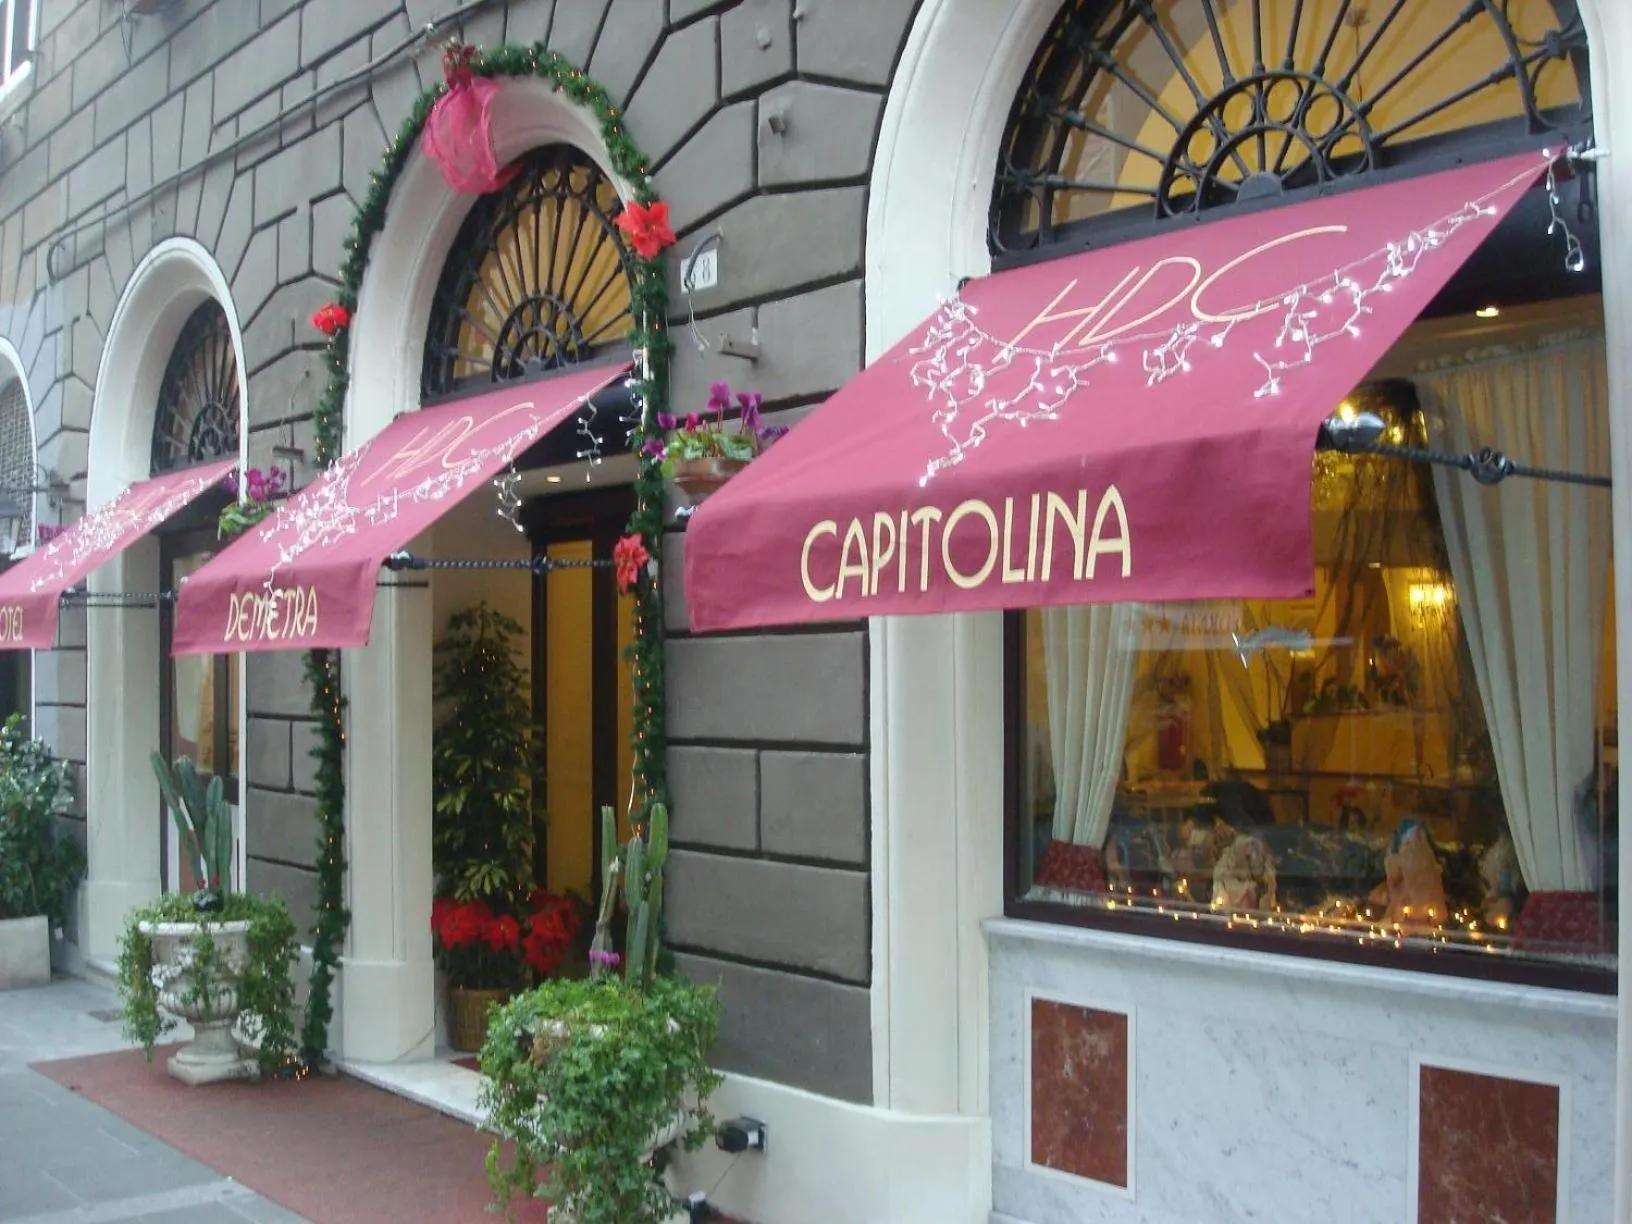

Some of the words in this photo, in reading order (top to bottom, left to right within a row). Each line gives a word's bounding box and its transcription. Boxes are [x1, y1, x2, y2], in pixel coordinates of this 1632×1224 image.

[992, 225, 1347, 364] HDC
[801, 484, 1132, 602] CAPITOLINA
[224, 585, 318, 642] DEMETRA
